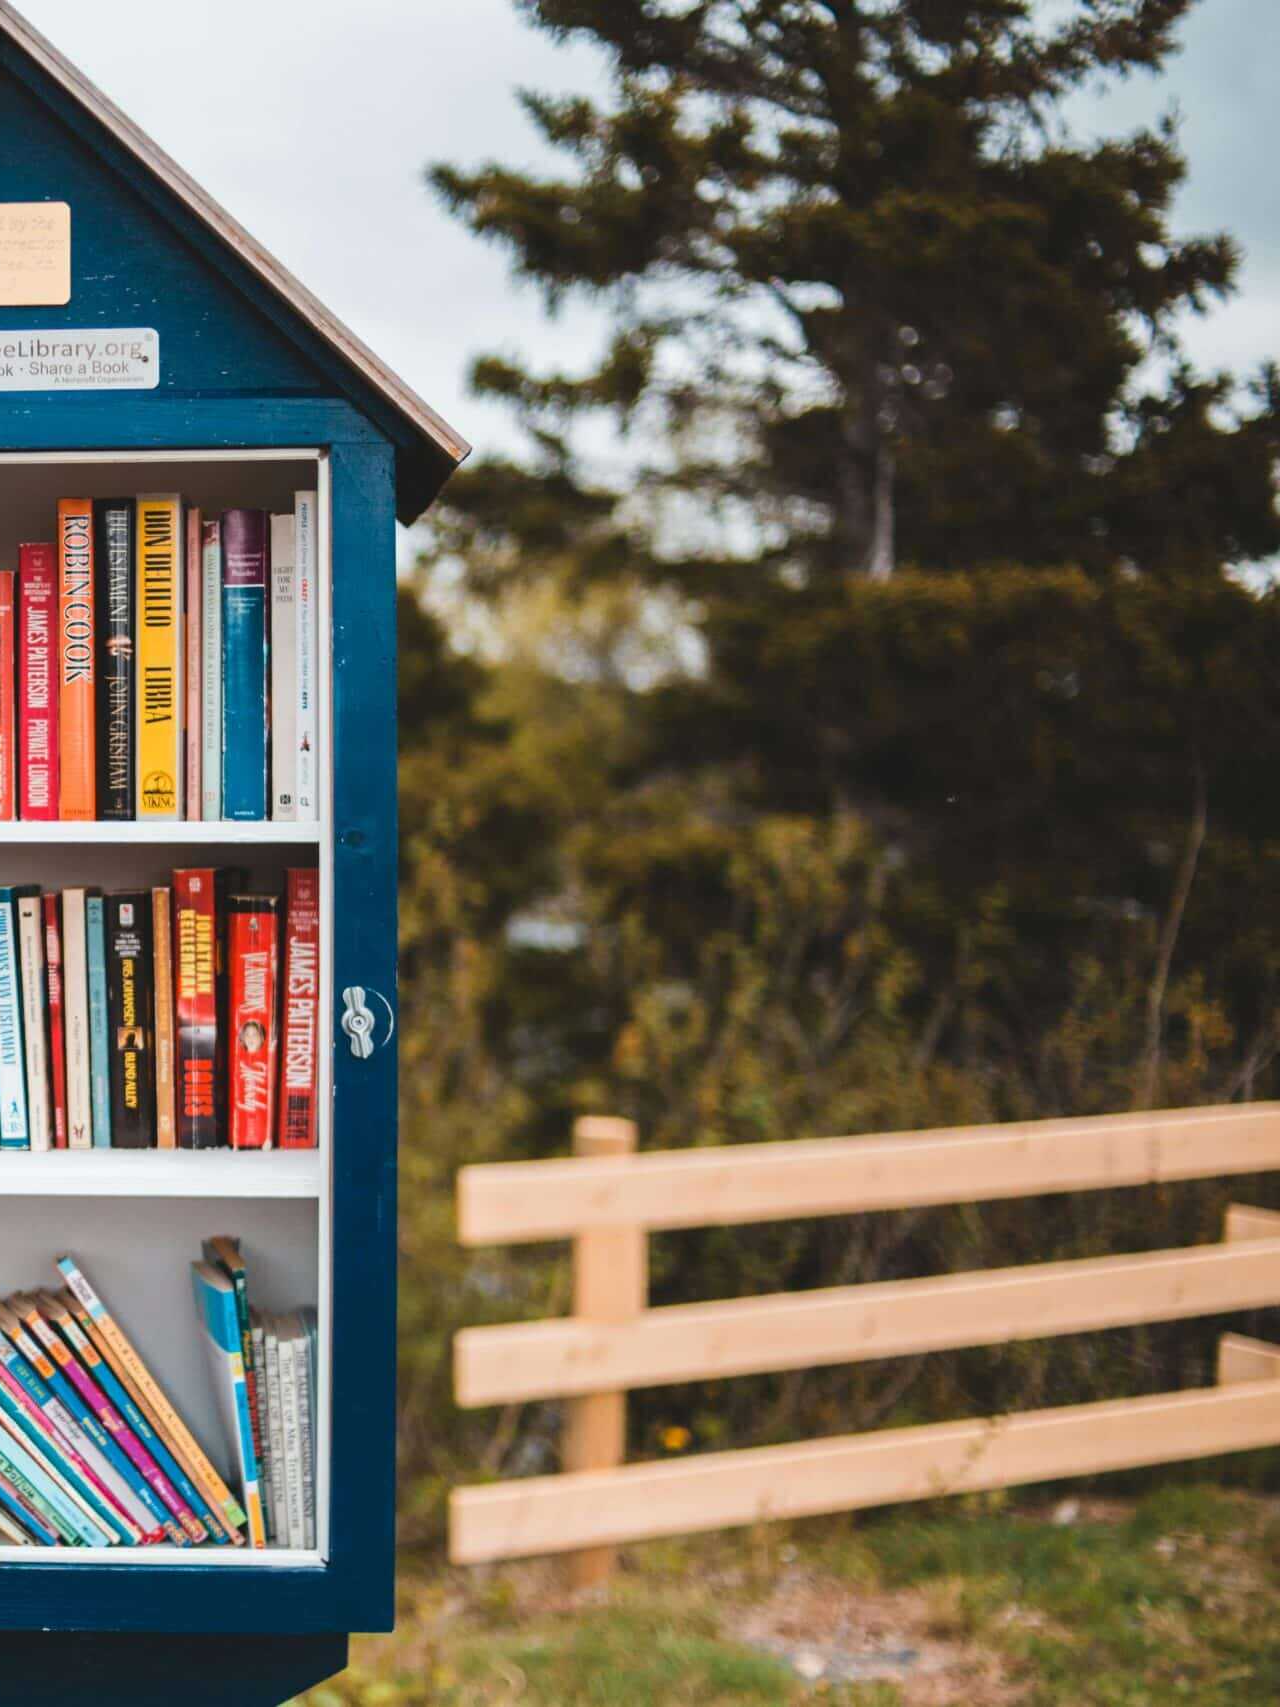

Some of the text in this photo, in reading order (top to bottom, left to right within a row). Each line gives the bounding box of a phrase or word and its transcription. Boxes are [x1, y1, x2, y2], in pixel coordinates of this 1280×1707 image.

[29, 362, 73, 376] Share
[78, 365, 86, 375] a
[91, 361, 130, 374] Book
[301, 503, 309, 528] PEOPLE
[107, 509, 128, 624] THE TESTAMENT
[144, 510, 172, 628] DON DELILLO
[27, 606, 49, 644] JAMES
[63, 514, 93, 685] ROBIN COOK
[27, 647, 49, 708] PATTERSON
[145, 667, 172, 725] LIBRA
[27, 720, 49, 807] PRIVATE LONDON
[105, 676, 128, 790] JOHN GRISHAM
[179, 909, 196, 999] KELLERMAN
[196, 914, 213, 995] JONATHAN
[289, 936, 316, 996] JAMES
[122, 959, 136, 1026] IRIS JOHANSEN
[0, 1003, 17, 1066] TESTAMENT
[286, 998, 314, 1089] PATTERSON
[124, 1052, 137, 1109] BLIND ALLEY
[184, 1059, 214, 1118] BONES
[235, 1060, 268, 1113] Melody
[282, 1358, 293, 1377] THE
[283, 1381, 295, 1404] TALE
[267, 1348, 285, 1503] THE TALE OF TOM KITTEN
[285, 1410, 296, 1424] OF
[297, 1351, 313, 1520] THE TALE OF BENJAMIN BUNNY
[288, 1457, 300, 1529] TITTLEMOUSE
